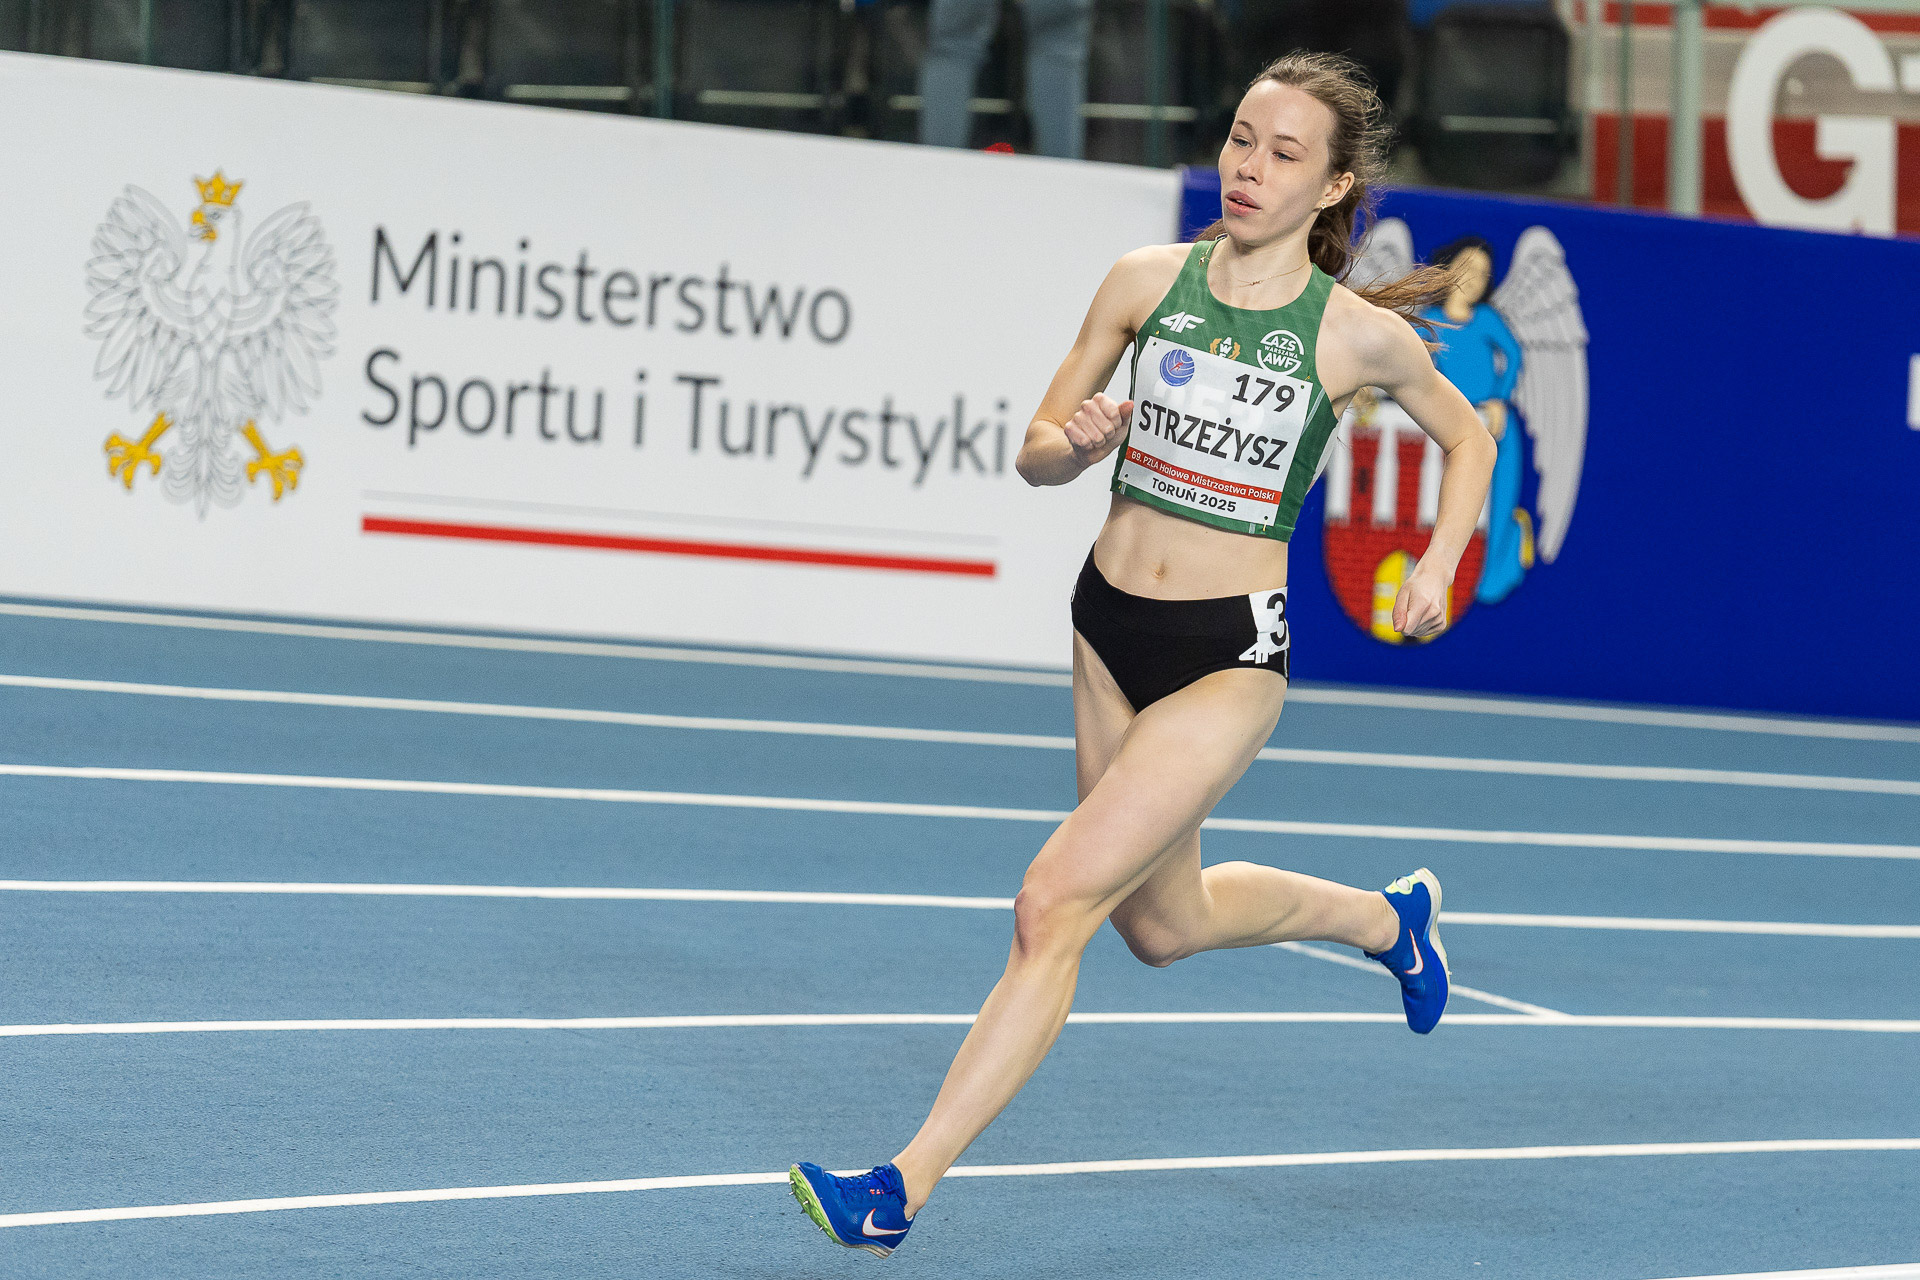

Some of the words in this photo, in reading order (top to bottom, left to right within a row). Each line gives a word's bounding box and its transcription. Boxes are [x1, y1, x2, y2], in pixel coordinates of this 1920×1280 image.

[1727, 3, 1920, 238] G
[370, 225, 853, 346] Ministerstwo
[1159, 310, 1206, 334] 4F
[1270, 335, 1297, 352] AZS
[1263, 352, 1296, 368] AWF
[1264, 345, 1298, 360] WARSZAWA
[1232, 373, 1296, 413] 179
[361, 346, 603, 449] Sportu
[632, 370, 648, 447] i
[674, 372, 1010, 487] Turystyki
[1138, 400, 1288, 471] STRZEŻYSZ
[1131, 450, 1142, 462] 69.
[1143, 456, 1159, 470] PZLA
[1160, 463, 1190, 480] Halowe
[1191, 474, 1246, 495] Mistrzostwa
[1248, 488, 1275, 501] Polski
[1152, 477, 1196, 502] TORUŃ
[1199, 493, 1237, 512] 2025
[1266, 592, 1287, 647] 3
